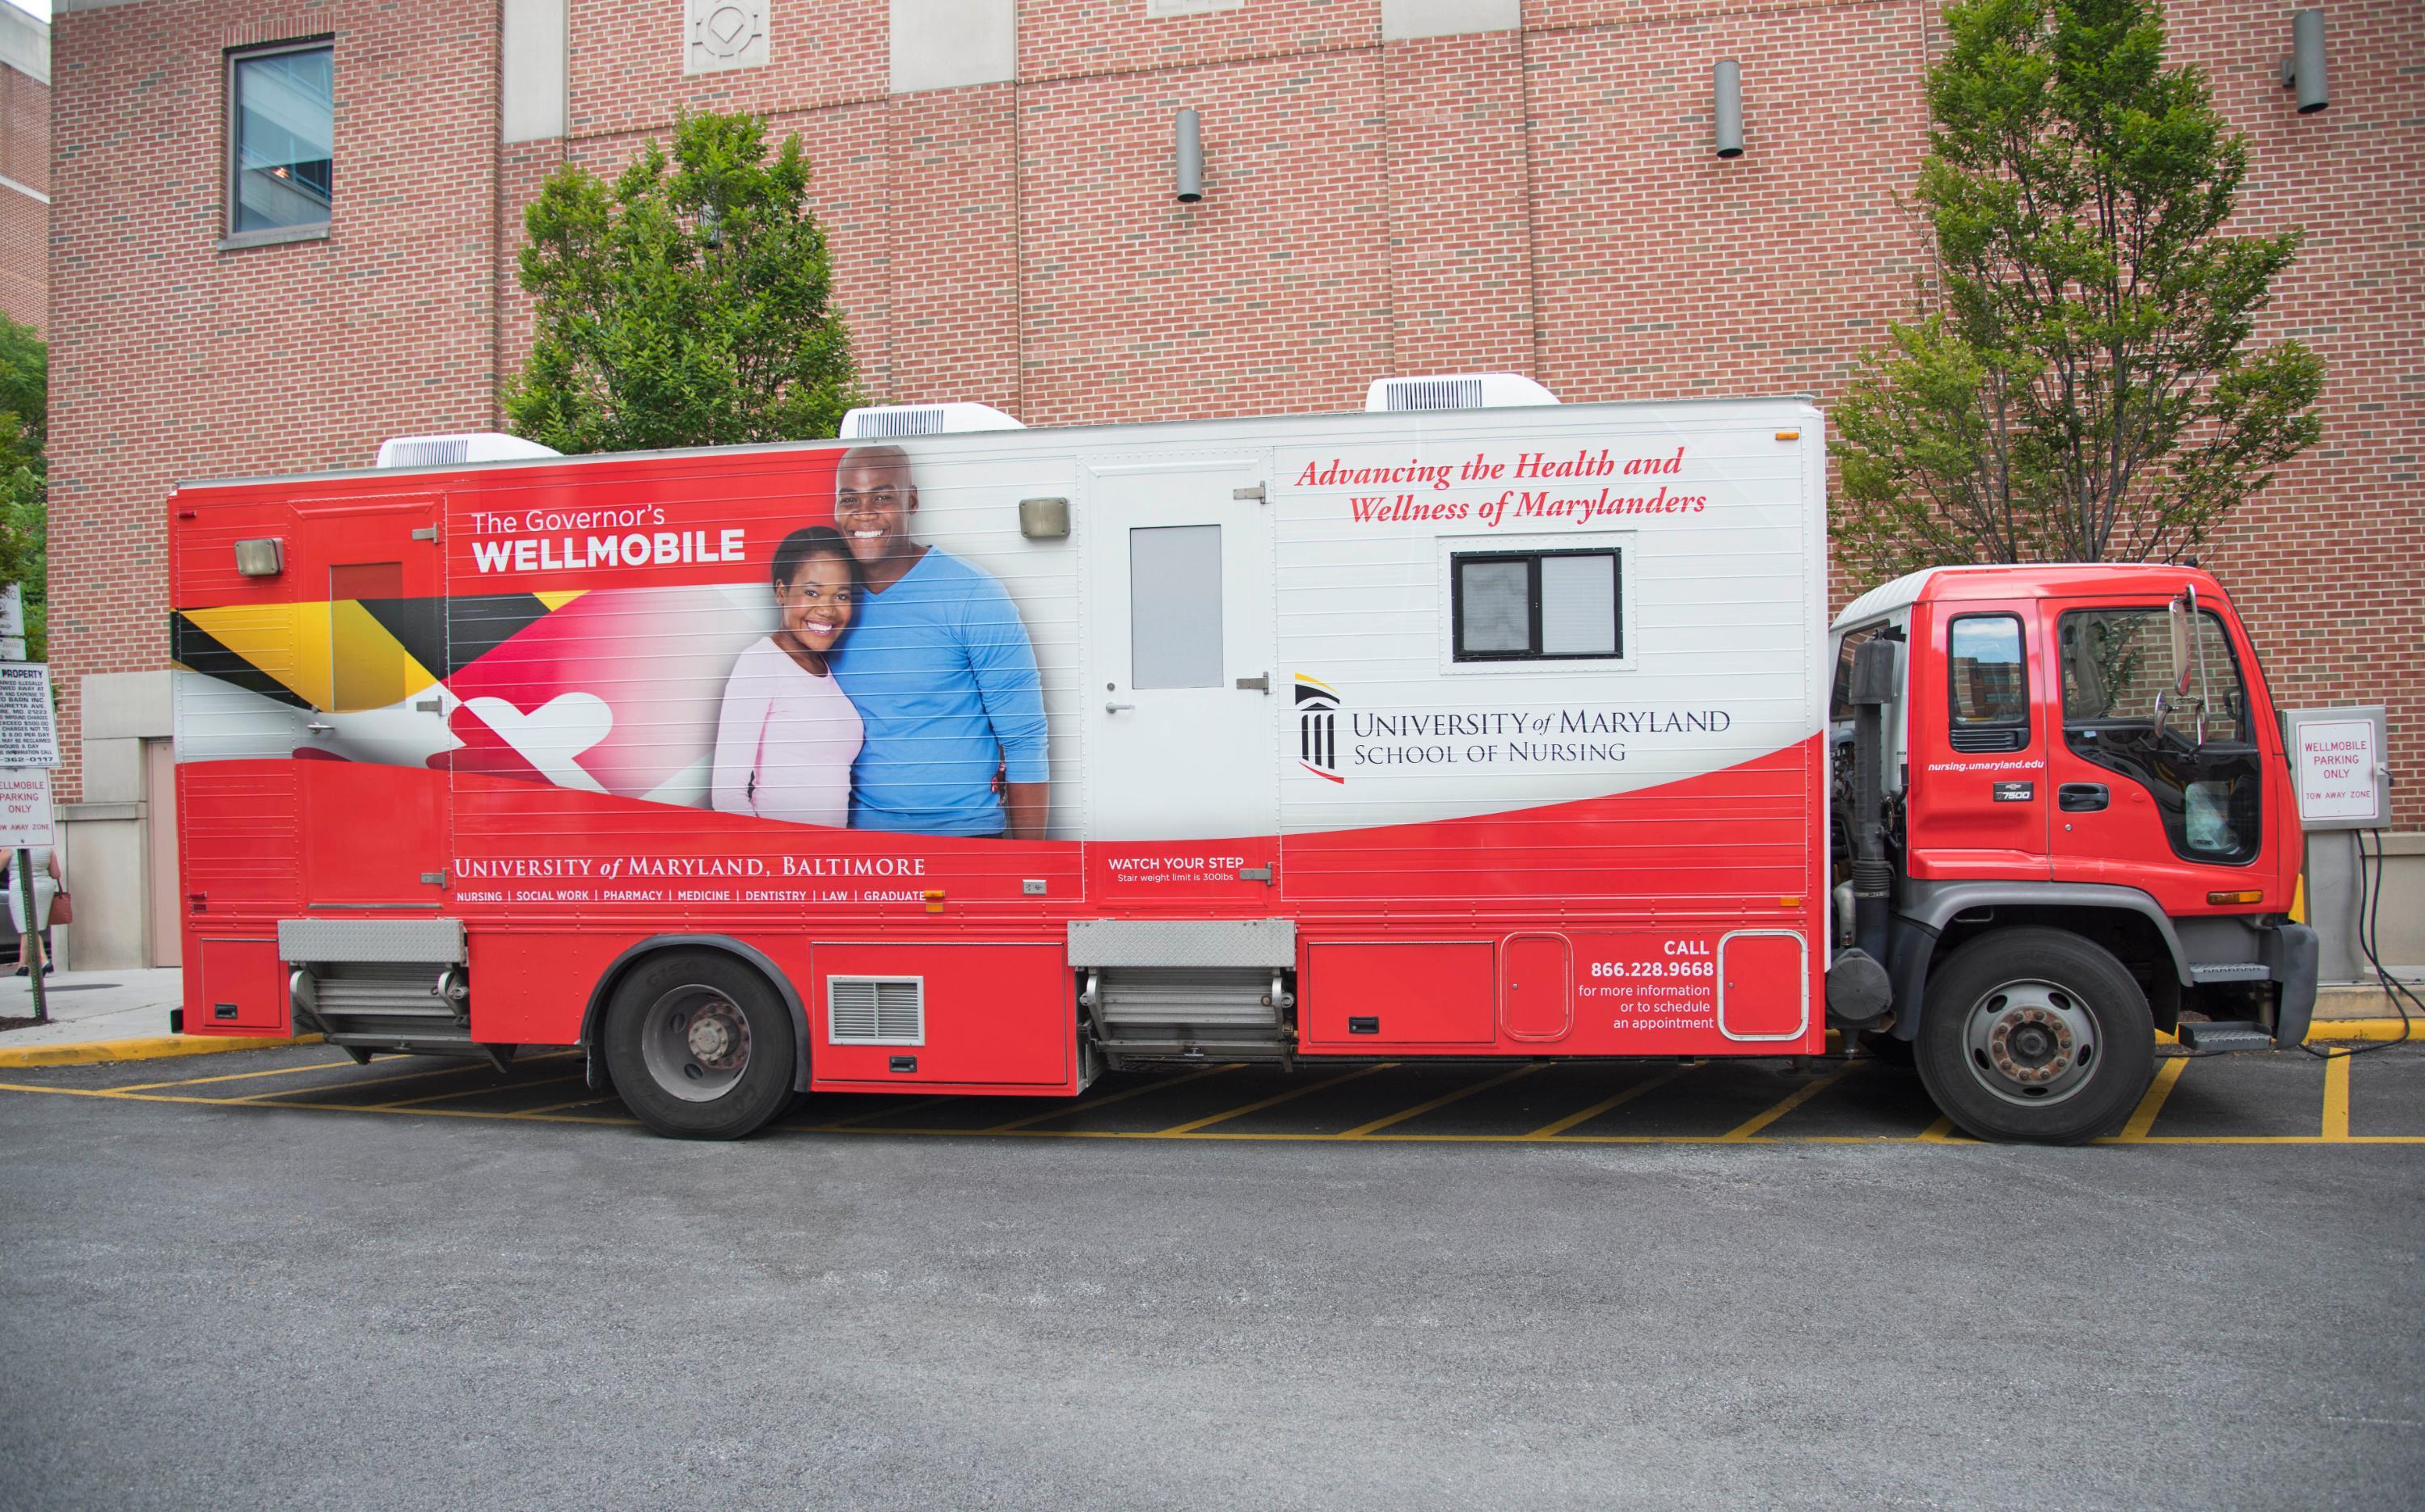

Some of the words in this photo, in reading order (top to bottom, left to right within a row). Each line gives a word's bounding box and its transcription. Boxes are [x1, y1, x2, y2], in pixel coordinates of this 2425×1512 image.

[1294, 458, 1453, 490] Advancing
[1461, 453, 1504, 479] the
[1513, 449, 1613, 478] Health
[1624, 447, 1685, 475] and
[1349, 495, 1469, 523] Wellness
[1478, 491, 1513, 527] of
[1513, 486, 1707, 525] Marylanders
[471, 512, 517, 534] The
[472, 529, 745, 573] WELLMOBILE
[2, 669, 43, 679] PROPERTY
[1533, 714, 1557, 737] of
[2305, 741, 2367, 752] WELLMOBILE
[1466, 744, 1498, 763] OF
[2313, 755, 2359, 764] PARKING
[1928, 760, 2044, 771] nursing.umaryland.edu
[2323, 769, 2350, 779] ONLY
[0, 781, 45, 790] ELLMOBILE
[0, 793, 39, 801] PARKING
[2351, 790, 2371, 798] ZONE
[8, 805, 32, 813] ONLY
[600, 858, 623, 879] of
[1107, 858, 1159, 870] WATCH
[1164, 857, 1204, 869] YOUR
[1208, 857, 1244, 868] STEP
[1140, 874, 1170, 882] weight
[1172, 873, 1191, 881] limit
[1203, 873, 1234, 881] 300lbs
[457, 892, 502, 901] NURSING
[517, 891, 555, 901] SOCIAL
[556, 891, 588, 900] WORK
[603, 891, 662, 901] PHARMACY
[678, 891, 730, 901] MEDICINE
[745, 891, 807, 901] DENTISTRY
[822, 891, 847, 901] LAW
[864, 891, 926, 901] GRADUATE
[1664, 941, 1710, 955] CALL
[1591, 962, 1714, 977] 866.228.9668
[1579, 985, 1596, 996] for
[1600, 988, 1633, 996] more
[1636, 984, 1710, 996] information
[1620, 1004, 1633, 1012] or
[1638, 1002, 1651, 1012] to
[1654, 1000, 1710, 1012] schedule
[1613, 1020, 1628, 1028] an
[1632, 1018, 1714, 1030] appointment
